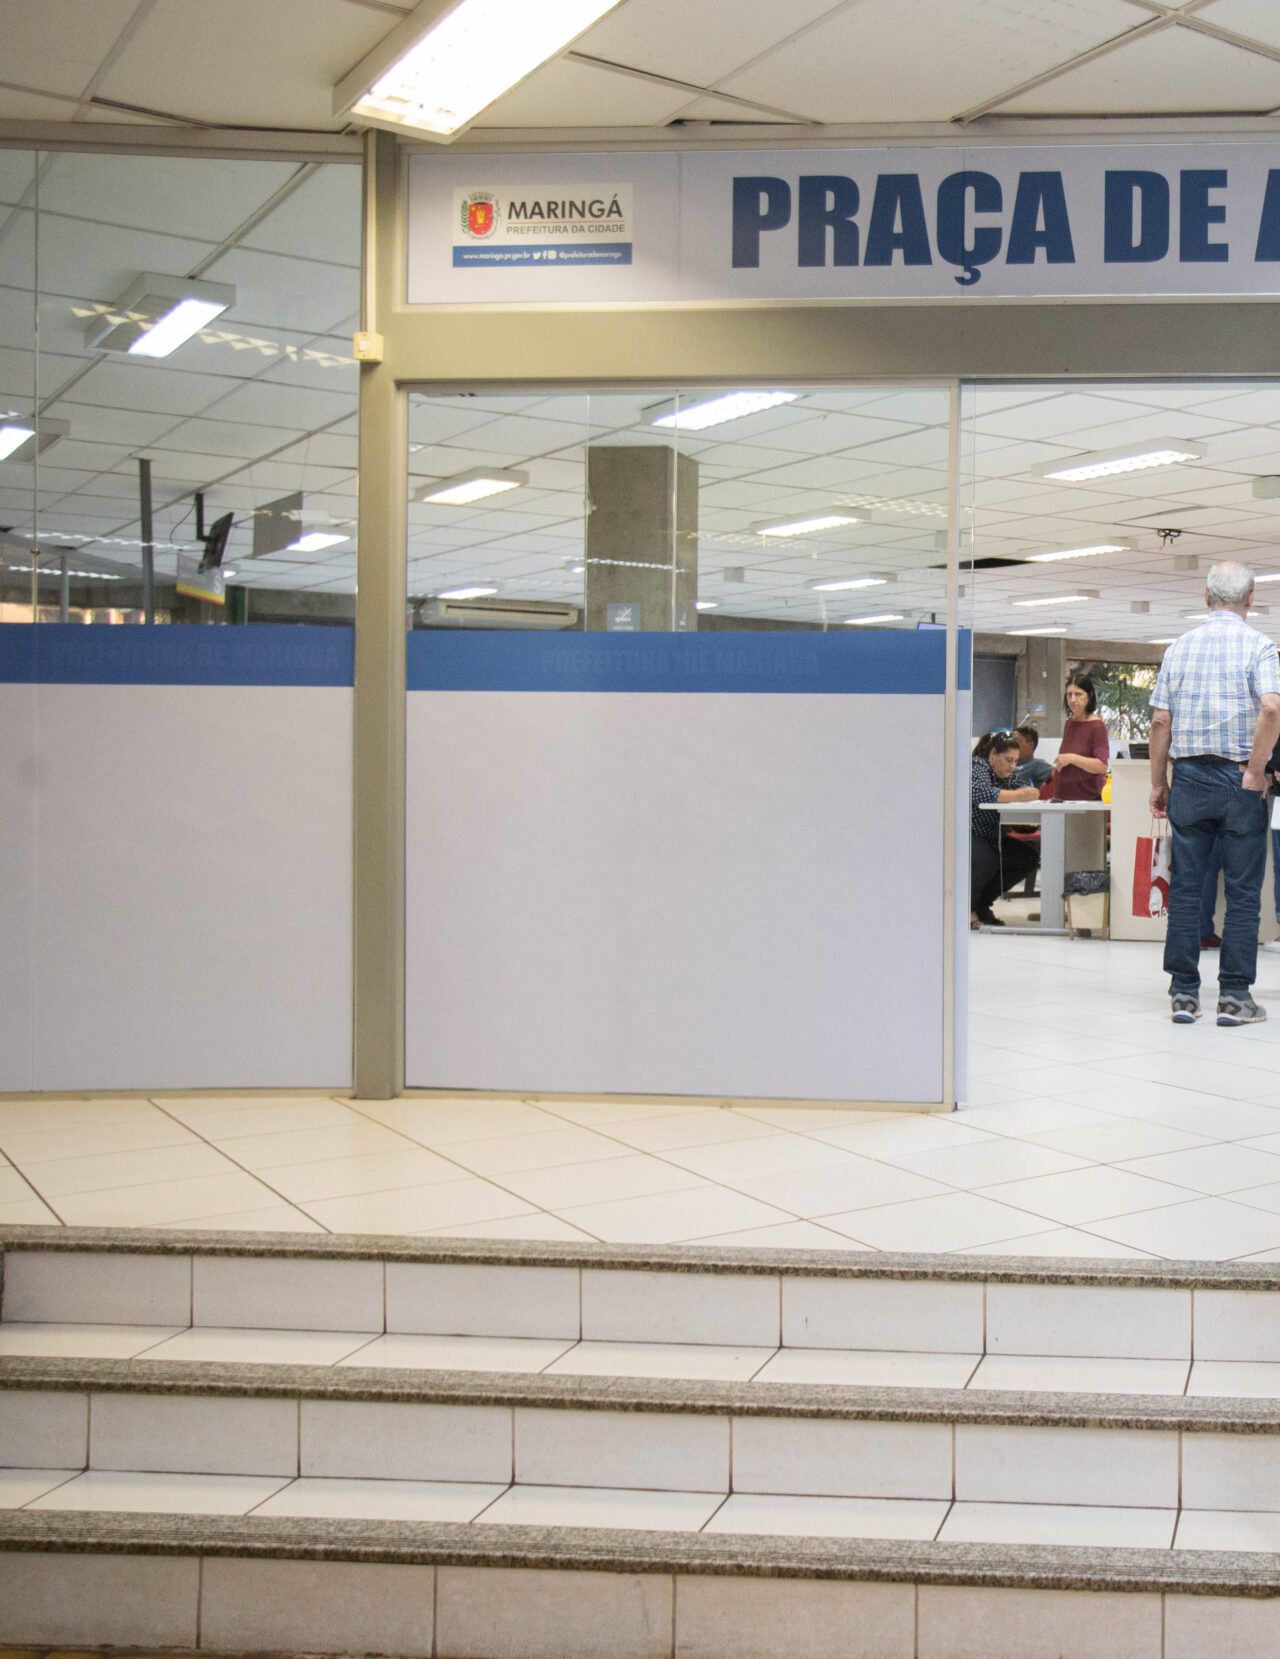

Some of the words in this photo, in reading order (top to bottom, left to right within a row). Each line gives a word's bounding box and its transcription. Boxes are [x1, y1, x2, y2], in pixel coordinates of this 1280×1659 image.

[507, 194, 623, 220] MARINGÁ
[506, 225, 569, 235] PREFEITURA
[571, 224, 586, 234] DA
[587, 223, 626, 233] CIDADE
[733, 170, 1075, 286] PRAÇA
[1104, 169, 1229, 263] DE
